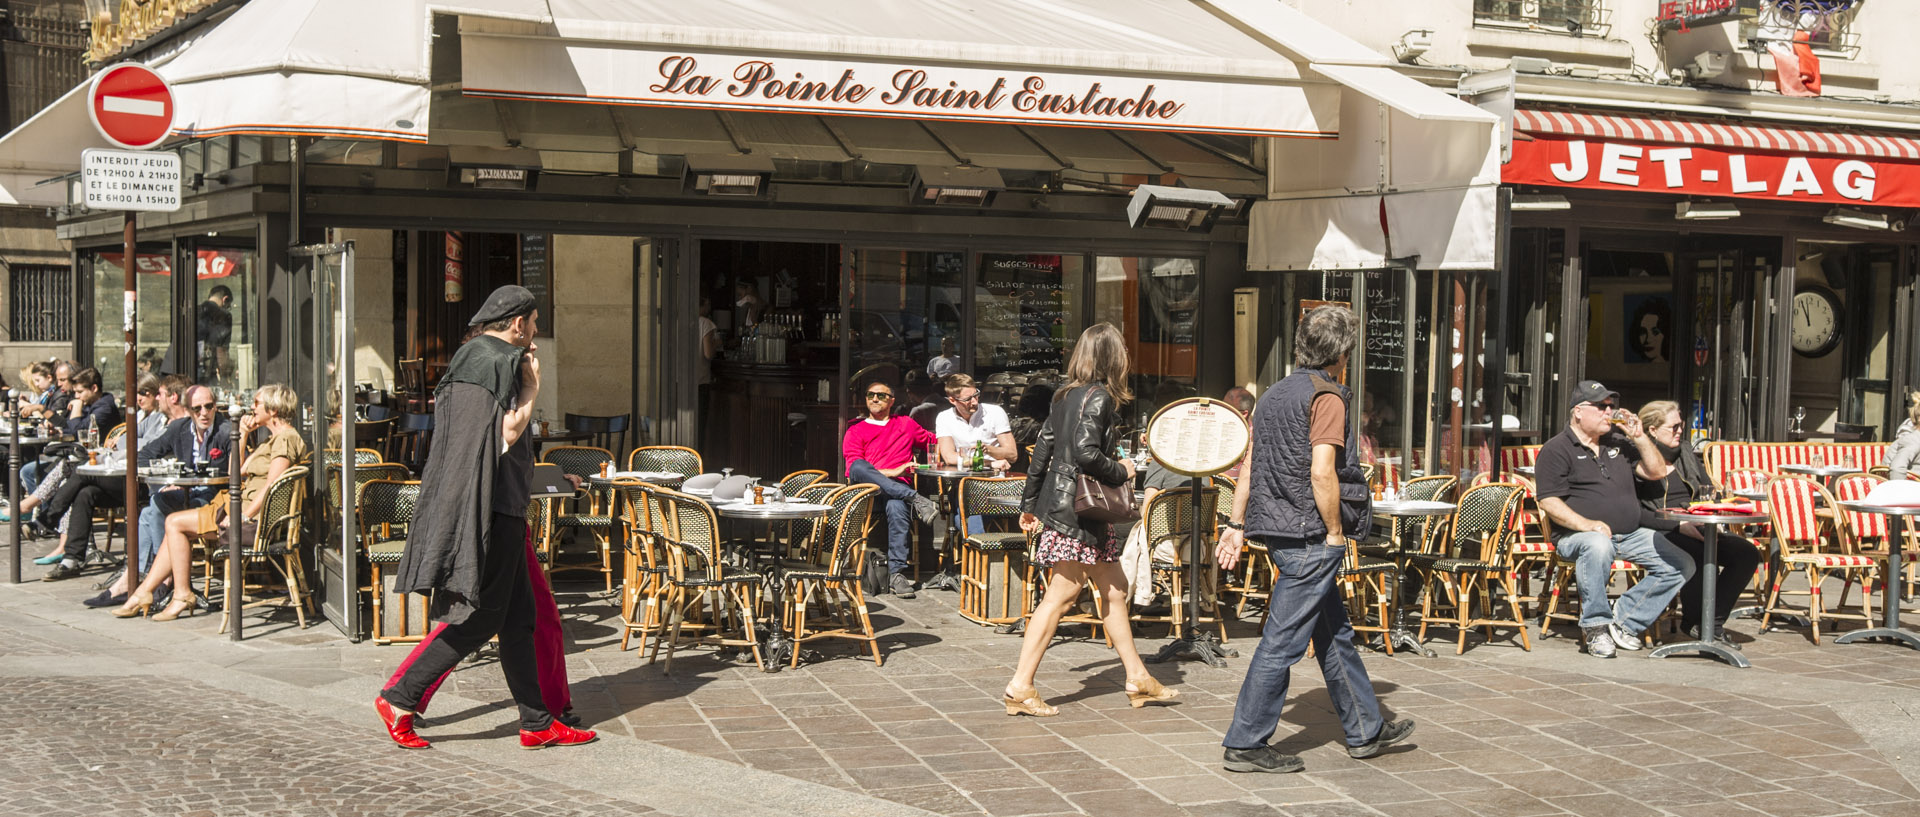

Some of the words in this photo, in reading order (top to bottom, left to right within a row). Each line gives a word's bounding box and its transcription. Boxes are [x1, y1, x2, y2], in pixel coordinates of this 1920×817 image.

[649, 55, 722, 95] La
[727, 60, 875, 104] Pointe
[881, 69, 1007, 111] Saint
[1011, 75, 1186, 119] Eustache
[92, 156, 138, 165] INTERDIT
[143, 159, 173, 167] JEUDI
[103, 169, 135, 178] 12H00
[148, 171, 178, 180] 21H30
[1550, 140, 1876, 201] JET-LAG
[121, 182, 174, 192] DIMANCHE
[106, 194, 132, 203] 6H00
[146, 196, 176, 204] 15H30
[994, 261, 1053, 270] SUGGESTIONS
[986, 281, 1025, 289] SALADE
